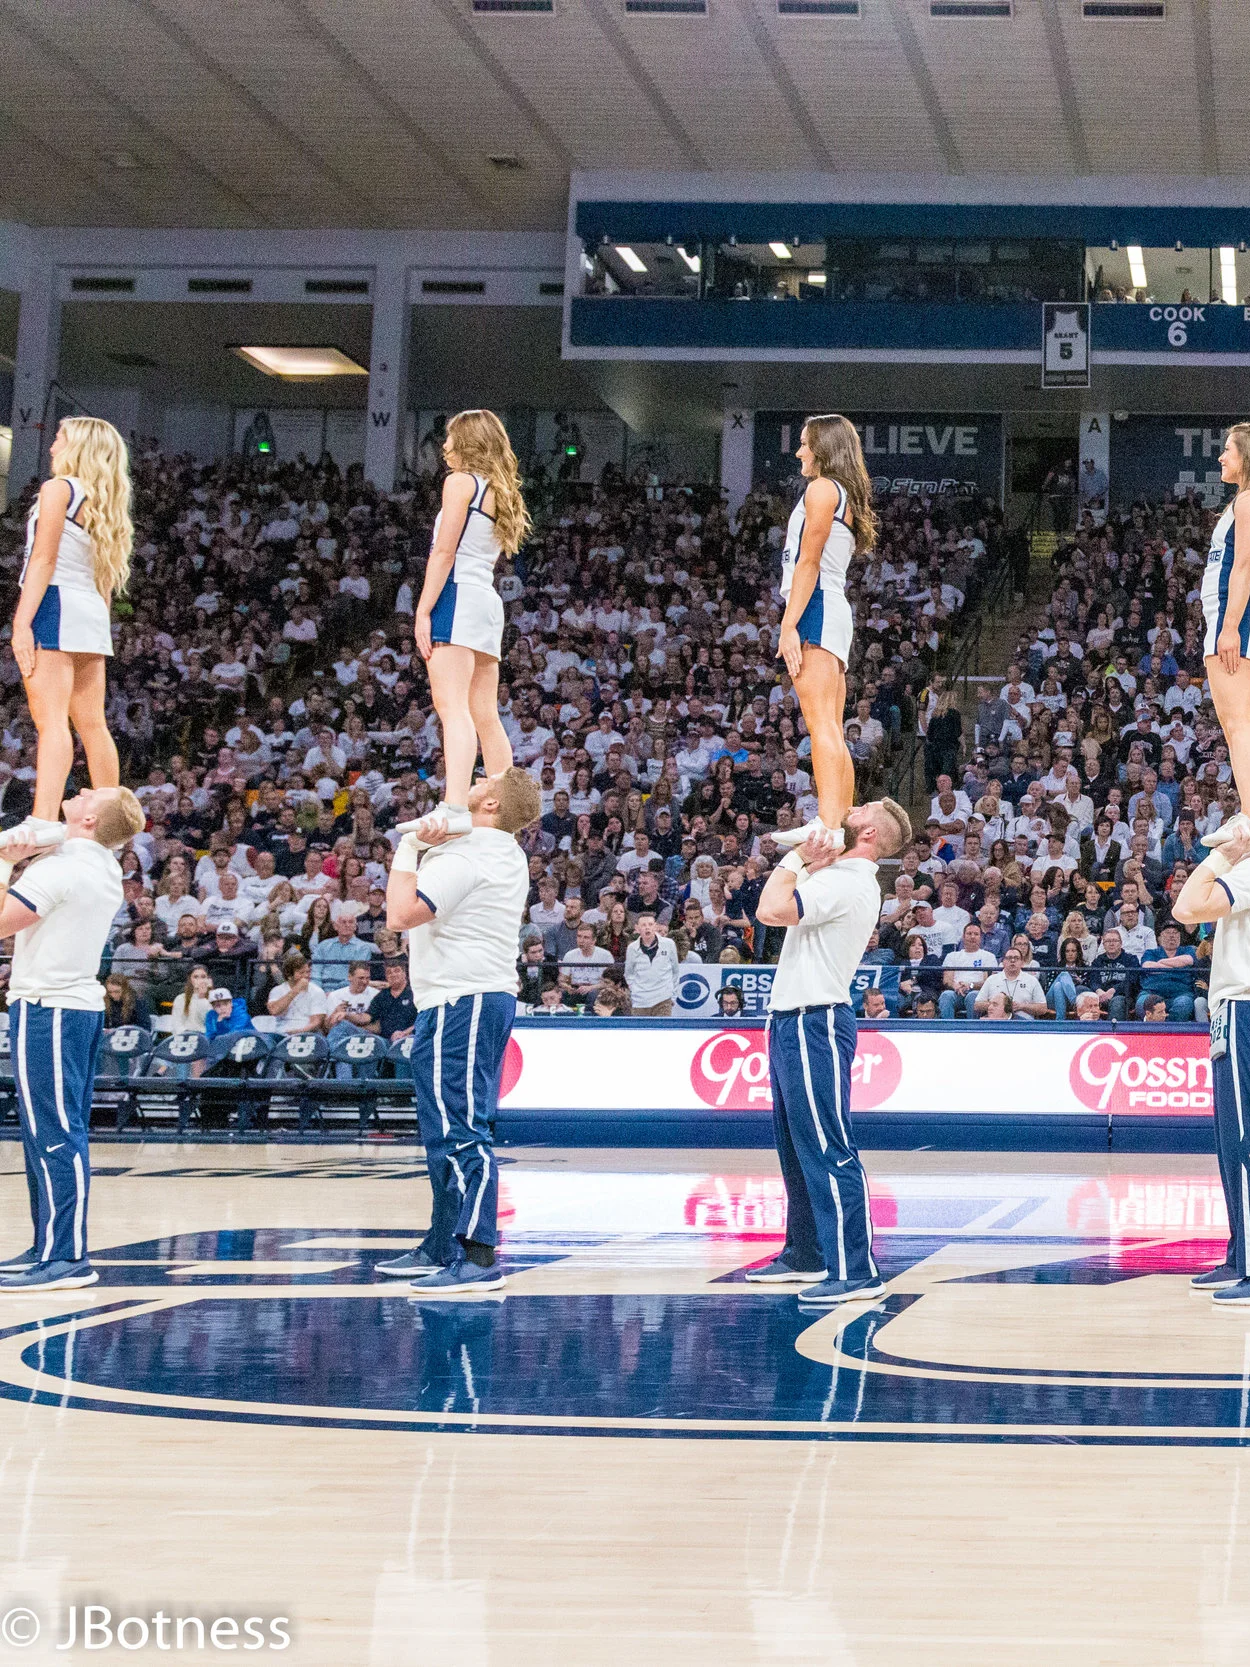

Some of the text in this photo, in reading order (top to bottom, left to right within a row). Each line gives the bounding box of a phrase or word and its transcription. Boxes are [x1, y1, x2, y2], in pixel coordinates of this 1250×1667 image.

[1150, 307, 1205, 321] COOK
[1168, 322, 1187, 346] 6
[1060, 342, 1073, 360] 5
[372, 411, 391, 427] W
[731, 414, 744, 429] X
[1088, 418, 1101, 433] A
[781, 425, 978, 455] I LIEVE
[726, 974, 772, 991] CBS
[1079, 1037, 1213, 1109] Gossn
[1129, 1091, 1213, 1107] FOOD
